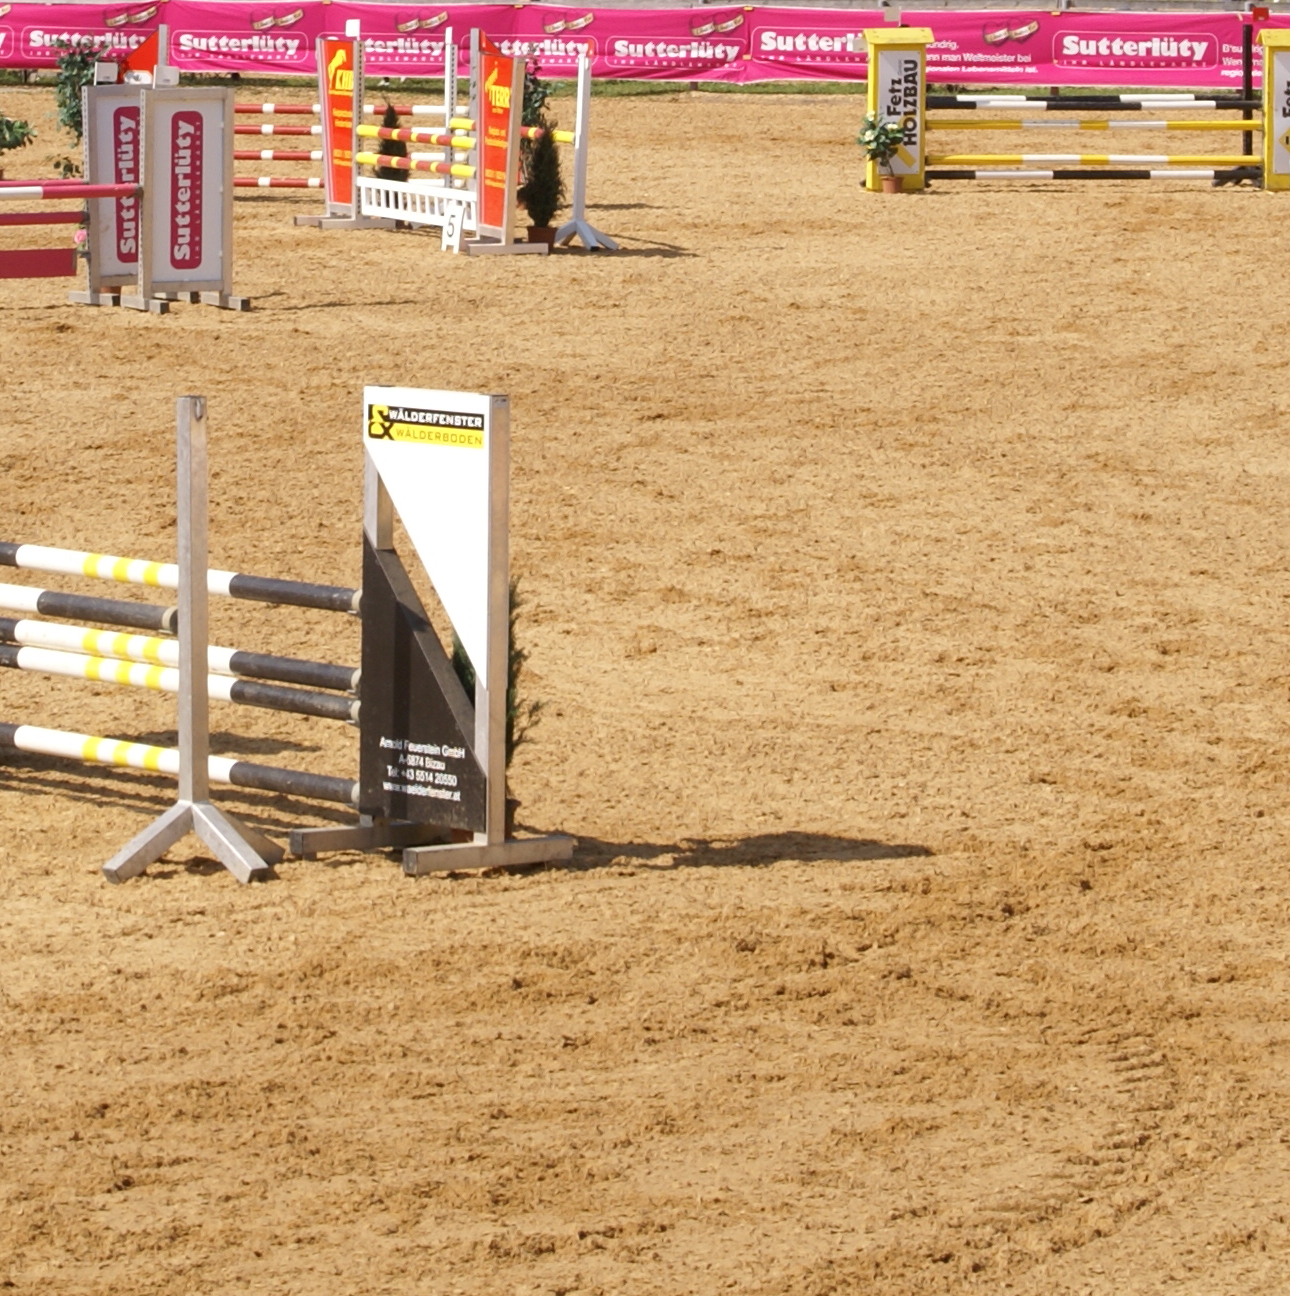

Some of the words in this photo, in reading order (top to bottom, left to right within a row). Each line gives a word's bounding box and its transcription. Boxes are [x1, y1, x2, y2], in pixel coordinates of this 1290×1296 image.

[179, 33, 299, 55] Sutterlüty
[614, 40, 740, 62] Sutterlüty
[1063, 36, 1208, 61] Sutterlüty
[887, 78, 903, 116] Fetz
[903, 59, 918, 146] HOLZBAU
[118, 115, 137, 254] Suttrlüty
[174, 120, 195, 260] Sutterlüty
[446, 214, 456, 238] 5
[416, 770, 434, 782] 5514
